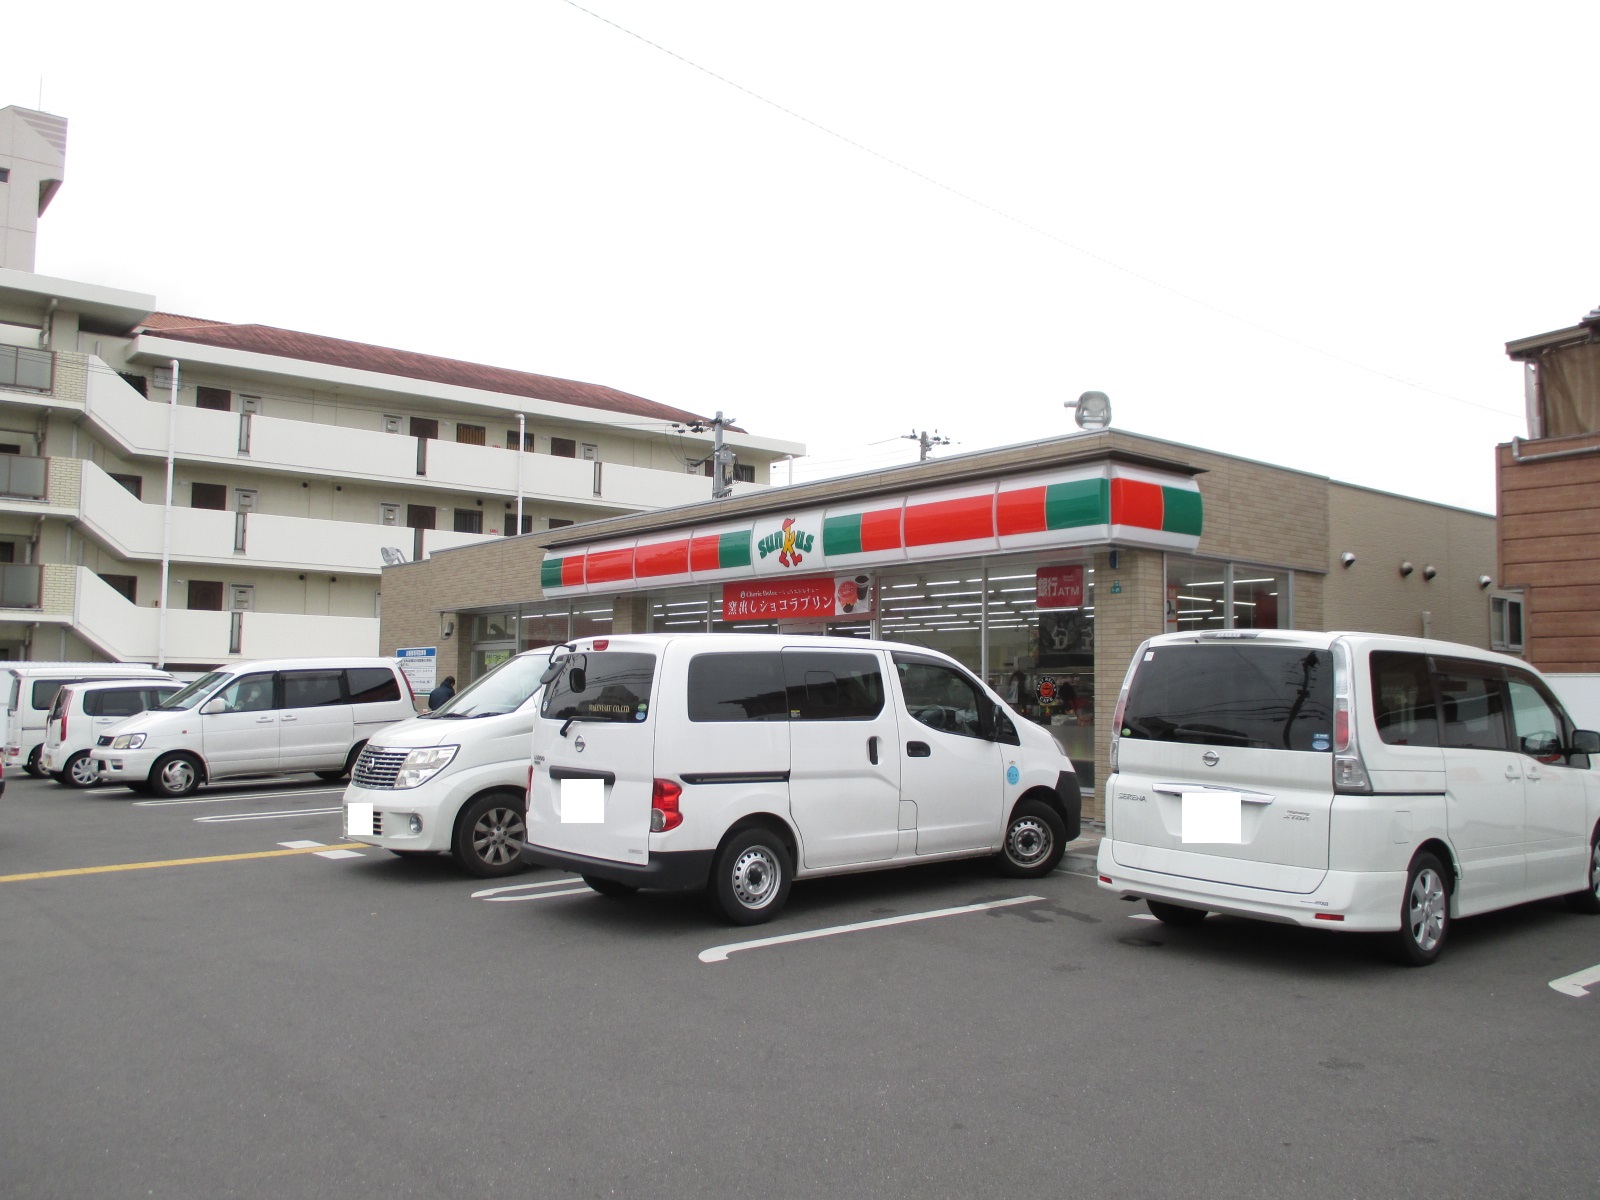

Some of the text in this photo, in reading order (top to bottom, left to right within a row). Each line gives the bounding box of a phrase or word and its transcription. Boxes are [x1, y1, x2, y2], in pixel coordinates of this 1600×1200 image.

[728, 596, 833, 615] 窯出しショコラプリン
[1117, 792, 1148, 803] SERENA
